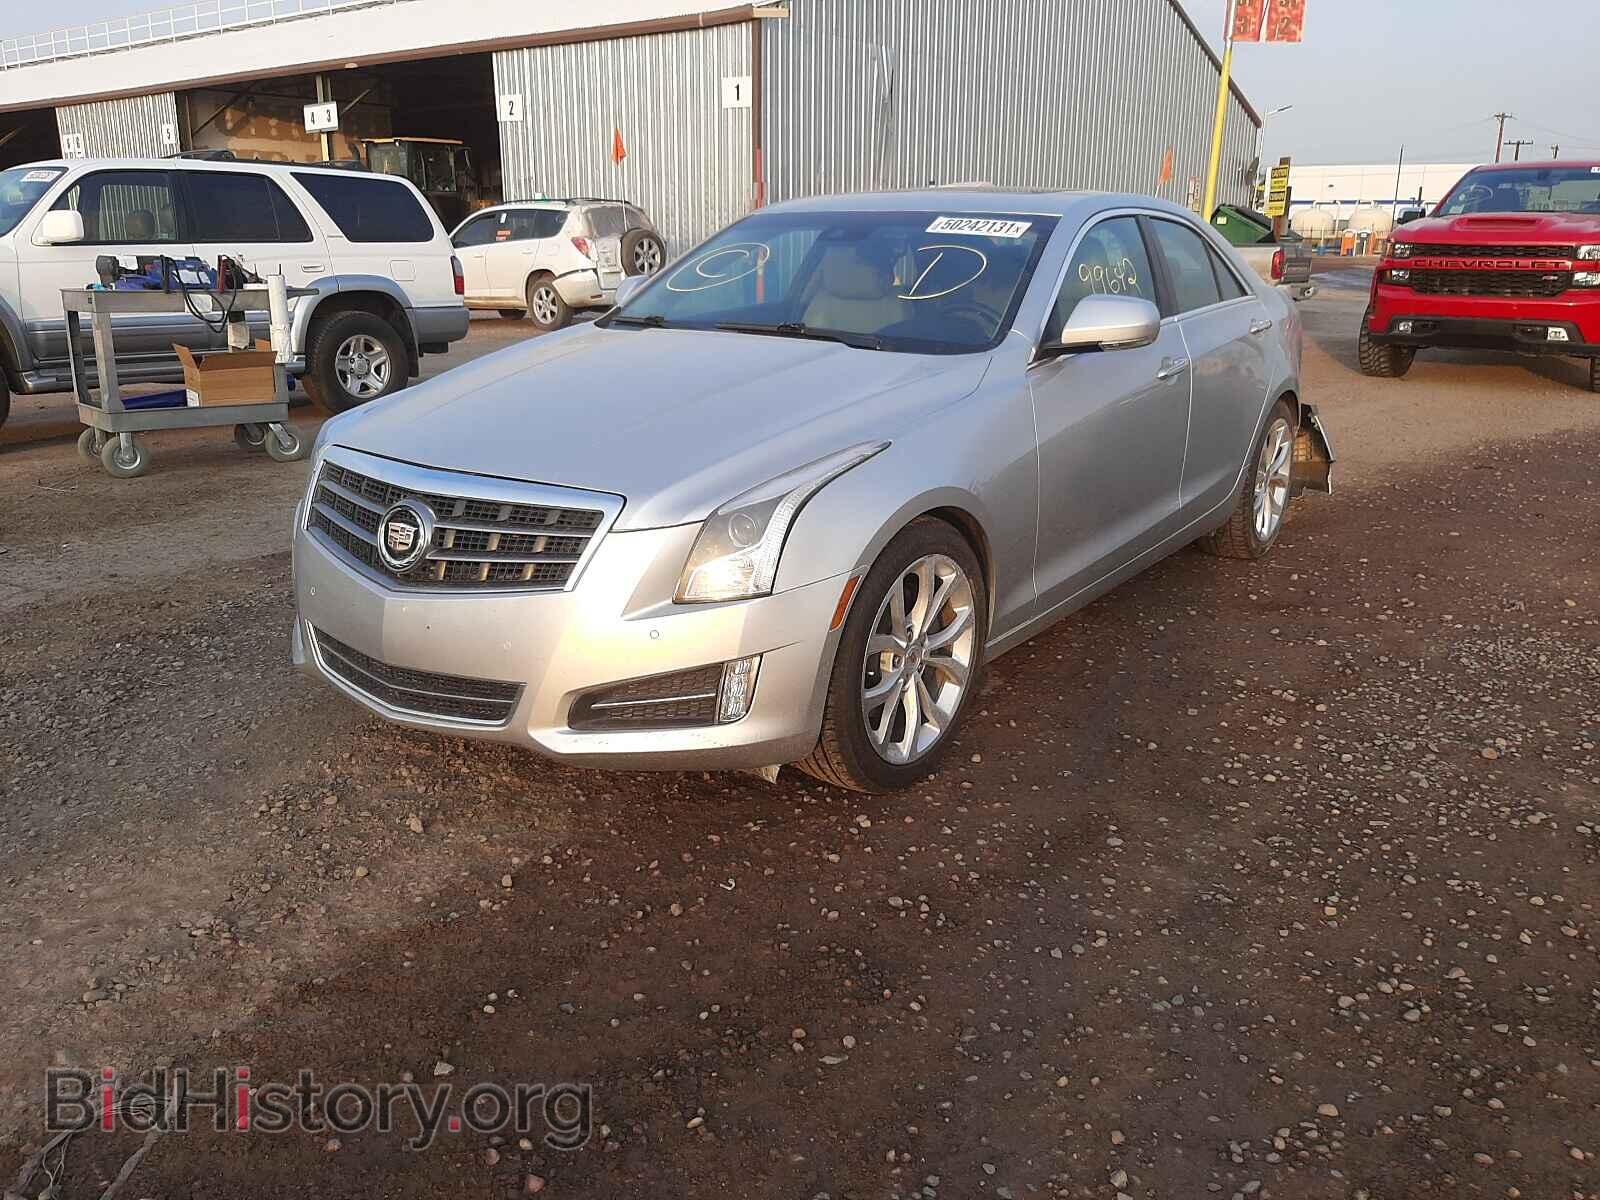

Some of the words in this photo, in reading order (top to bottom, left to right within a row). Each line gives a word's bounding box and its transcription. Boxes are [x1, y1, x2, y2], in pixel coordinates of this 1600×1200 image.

[734, 83, 740, 101] 1
[508, 100, 515, 116] 2
[326, 109, 332, 122] 3
[166, 128, 171, 140] 5
[1413, 259, 1567, 270] CHEVROLET
[898, 245, 988, 300] D
